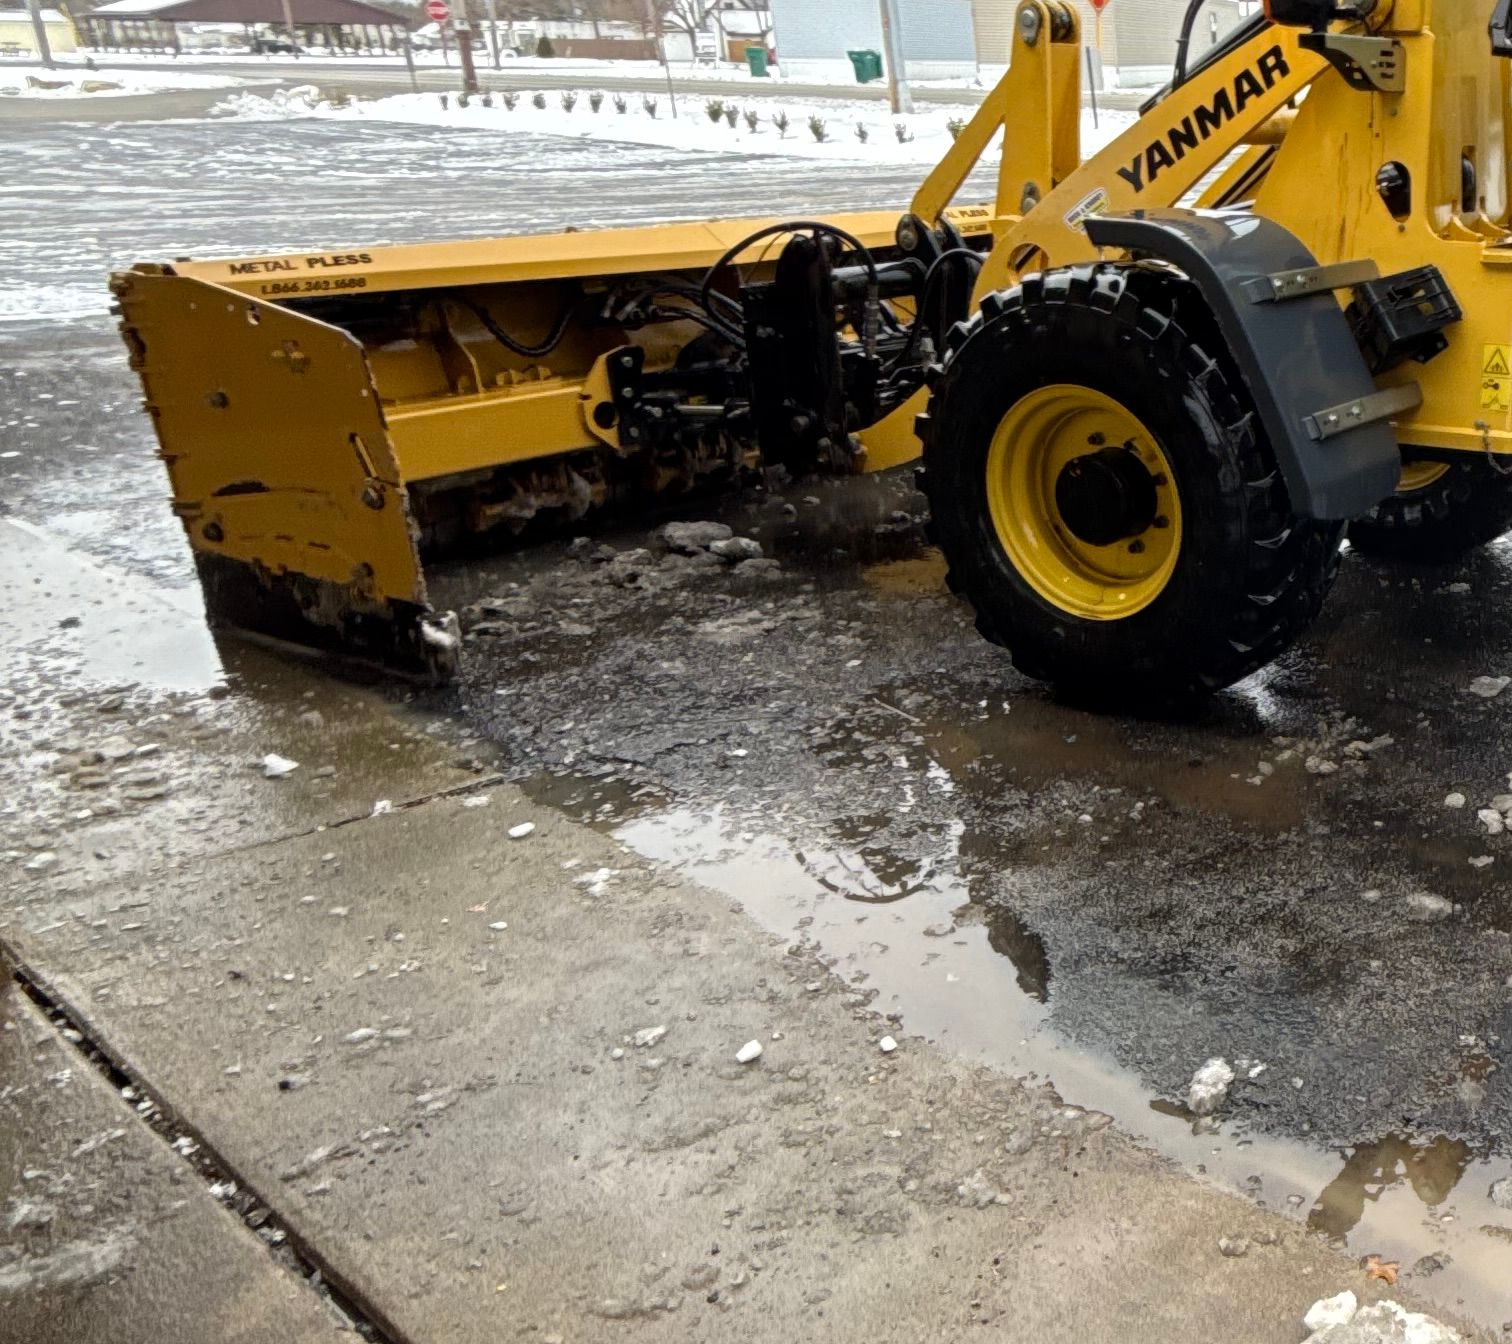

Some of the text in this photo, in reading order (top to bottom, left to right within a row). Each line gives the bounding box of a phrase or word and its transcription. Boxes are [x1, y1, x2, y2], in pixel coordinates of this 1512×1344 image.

[1116, 44, 1290, 193] YANMAR
[229, 253, 372, 275] METAL PLESS
